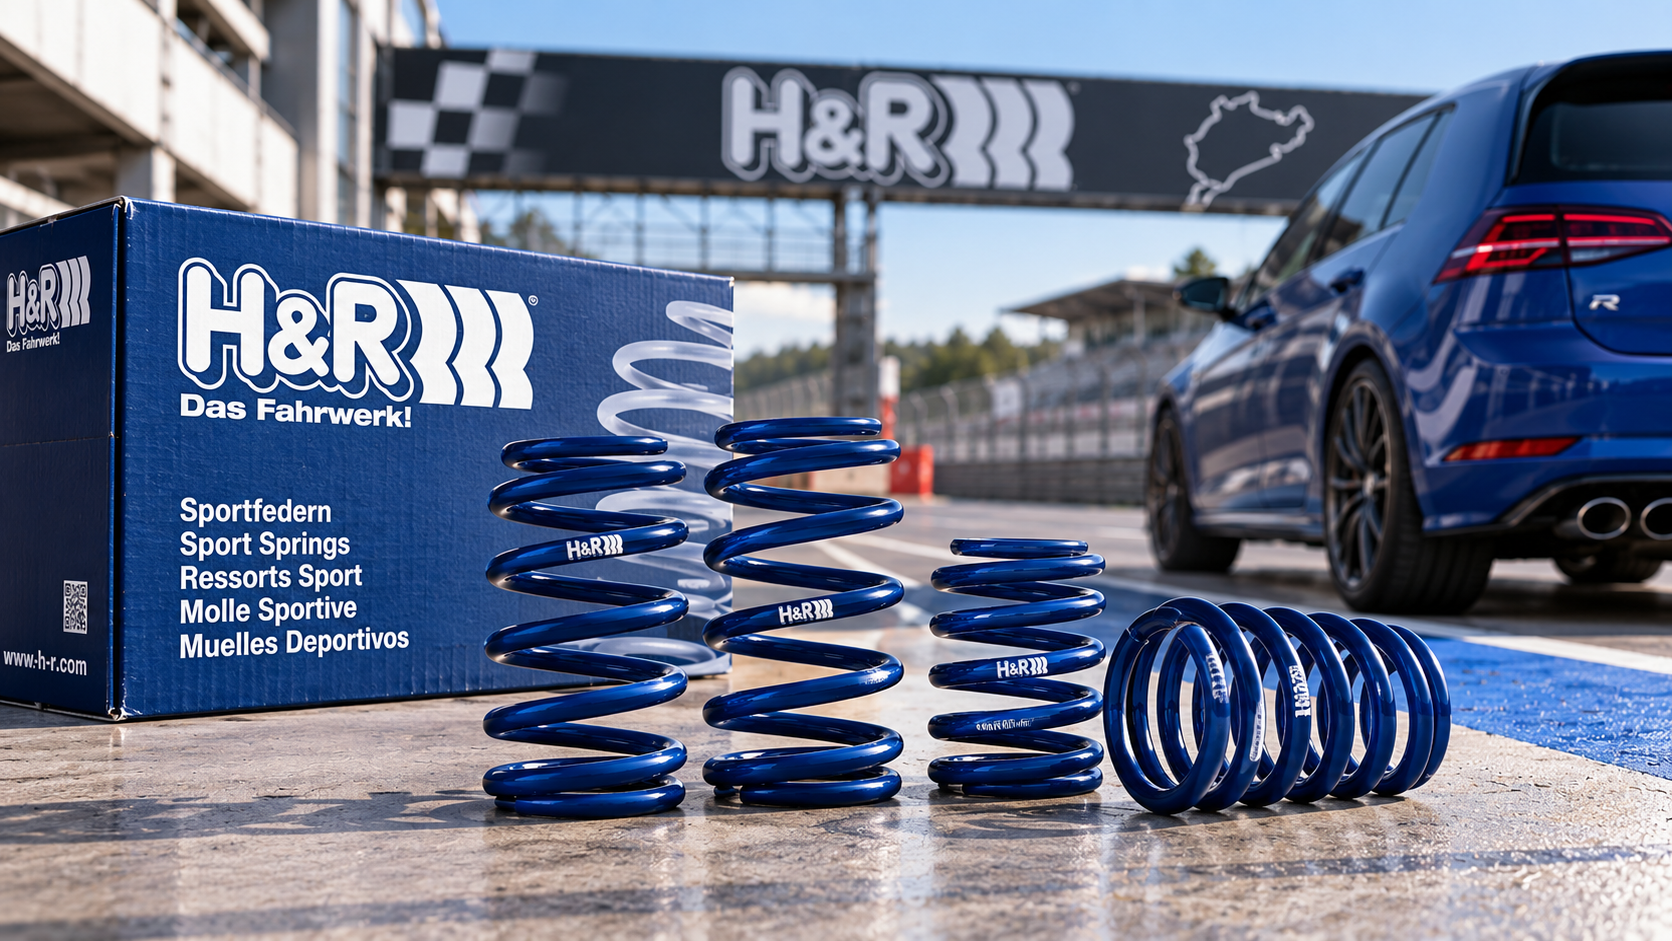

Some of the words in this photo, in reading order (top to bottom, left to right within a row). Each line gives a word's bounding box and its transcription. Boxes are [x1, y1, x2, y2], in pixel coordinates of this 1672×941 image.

[721, 66, 949, 189] H&R
[6, 263, 60, 338] H&R
[1589, 294, 1620, 311] R
[6, 340, 21, 353] Das
[22, 331, 60, 350] Fahrwerk!
[178, 257, 415, 402] H&R
[180, 393, 247, 420] Das
[256, 398, 412, 428] Fahrwerk!
[180, 497, 332, 528] Sportfedern
[180, 531, 252, 561] Sport
[259, 531, 350, 561] Springs
[566, 536, 603, 561] H&R
[180, 565, 292, 590] Ressorts
[298, 564, 363, 593] Sport
[180, 598, 251, 624] Molle
[258, 596, 358, 627] Sportive
[778, 601, 815, 625] H&R
[180, 631, 279, 659] Muelles
[286, 627, 410, 658] Deportivos
[996, 658, 1030, 679] H&R
